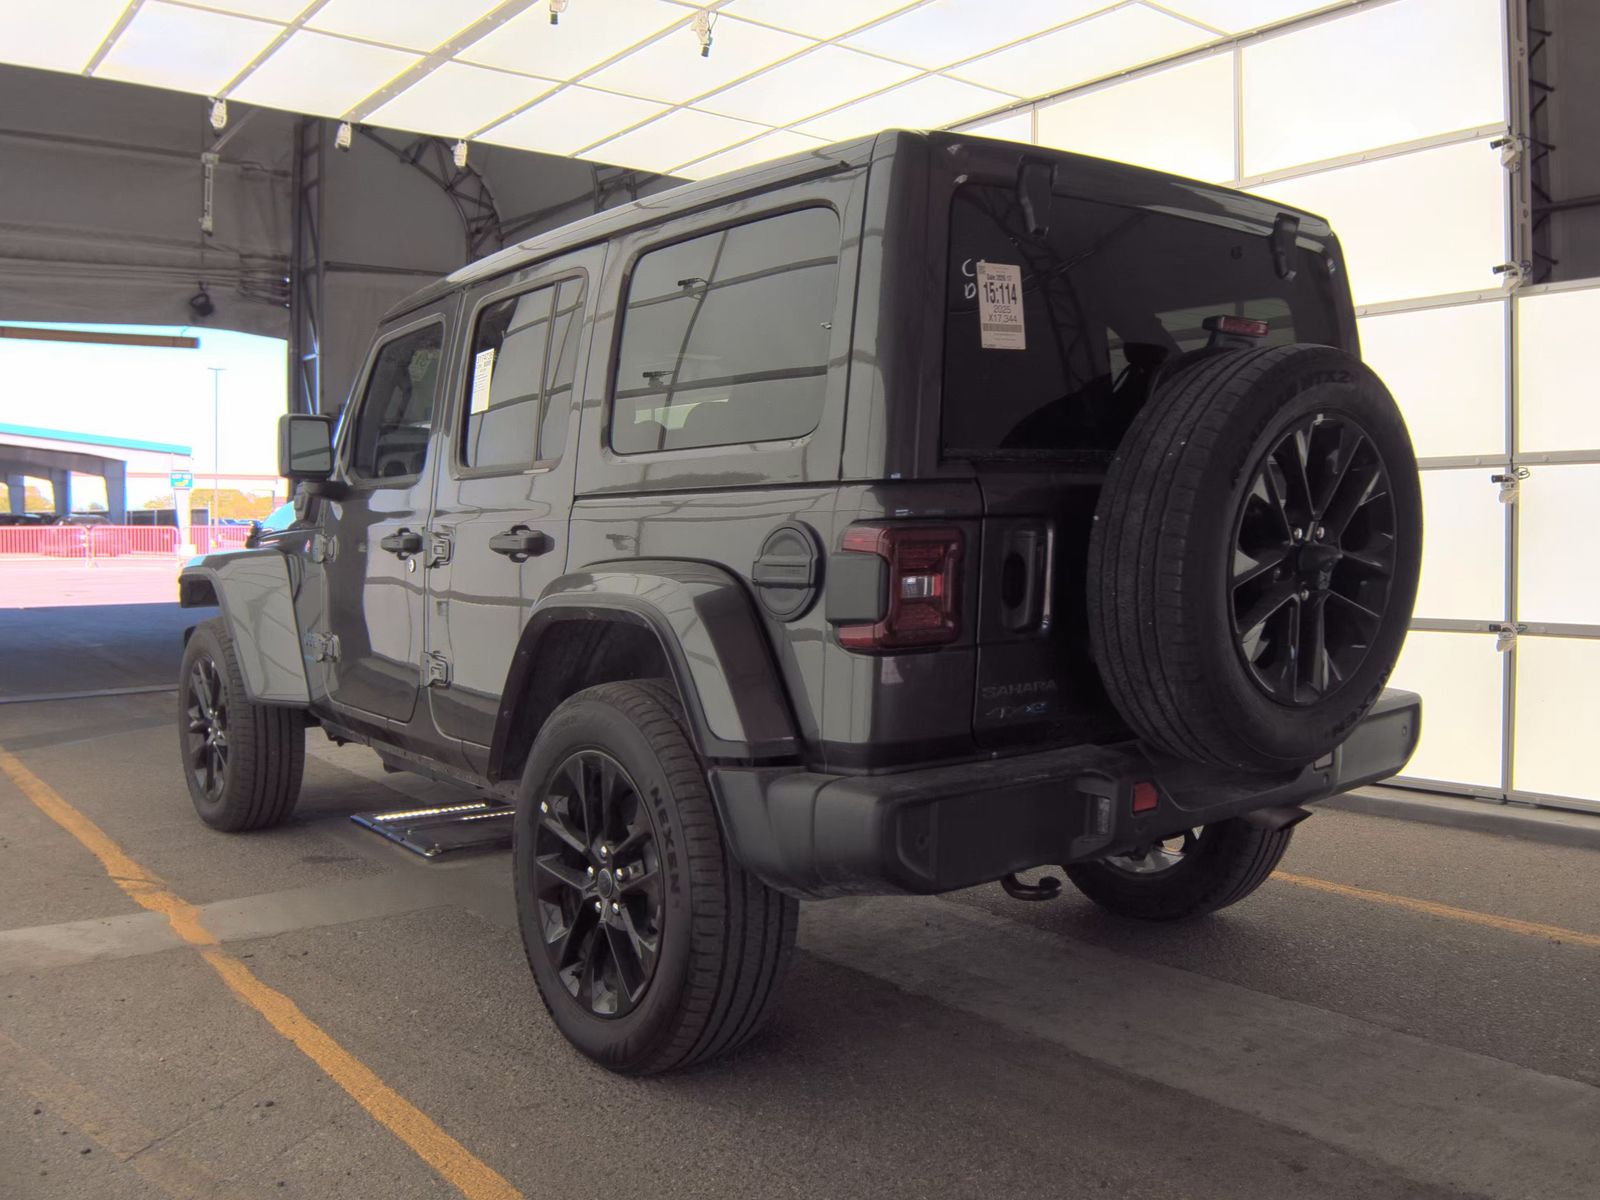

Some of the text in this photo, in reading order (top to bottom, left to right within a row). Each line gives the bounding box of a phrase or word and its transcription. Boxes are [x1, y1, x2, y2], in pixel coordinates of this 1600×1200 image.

[983, 282, 1017, 305] 15:114
[993, 304, 1012, 314] 2025
[981, 679, 1057, 699] SAHARA
[649, 785, 681, 895] NEXEN
